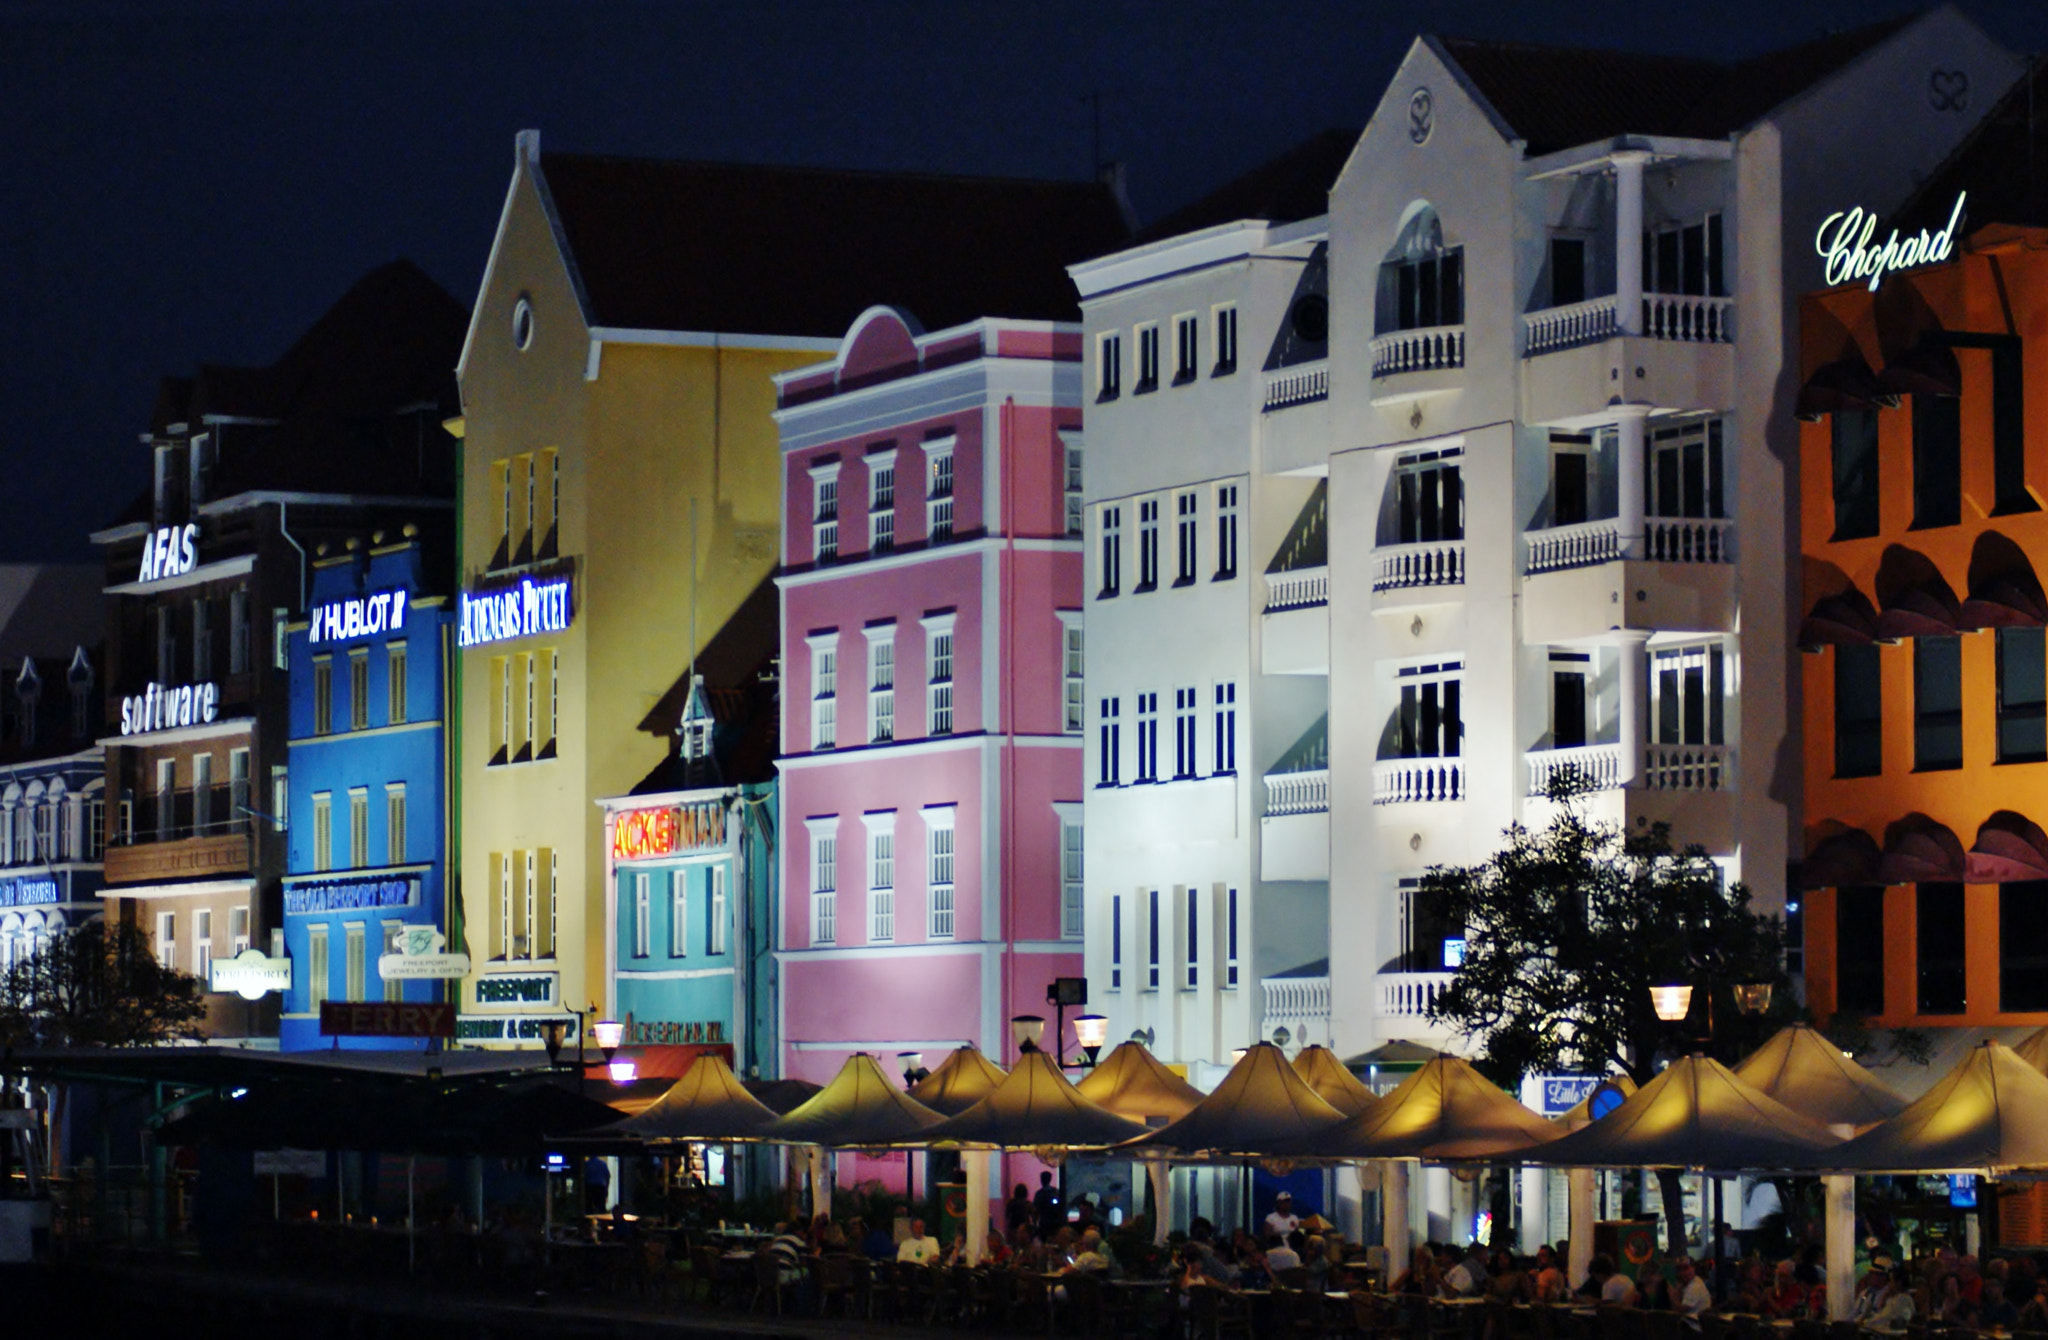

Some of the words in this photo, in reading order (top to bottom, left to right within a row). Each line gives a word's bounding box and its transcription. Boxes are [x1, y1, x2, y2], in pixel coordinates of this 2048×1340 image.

[1816, 190, 1966, 291] Chopard
[138, 523, 198, 582] AFAS
[325, 593, 391, 640] HUBLOT
[458, 593, 520, 646] AUDEMARS
[121, 681, 215, 735] software
[613, 806, 725, 858] ACKERMAN
[332, 1005, 446, 1033] FERRY
[1548, 1081, 1580, 1104] Little
